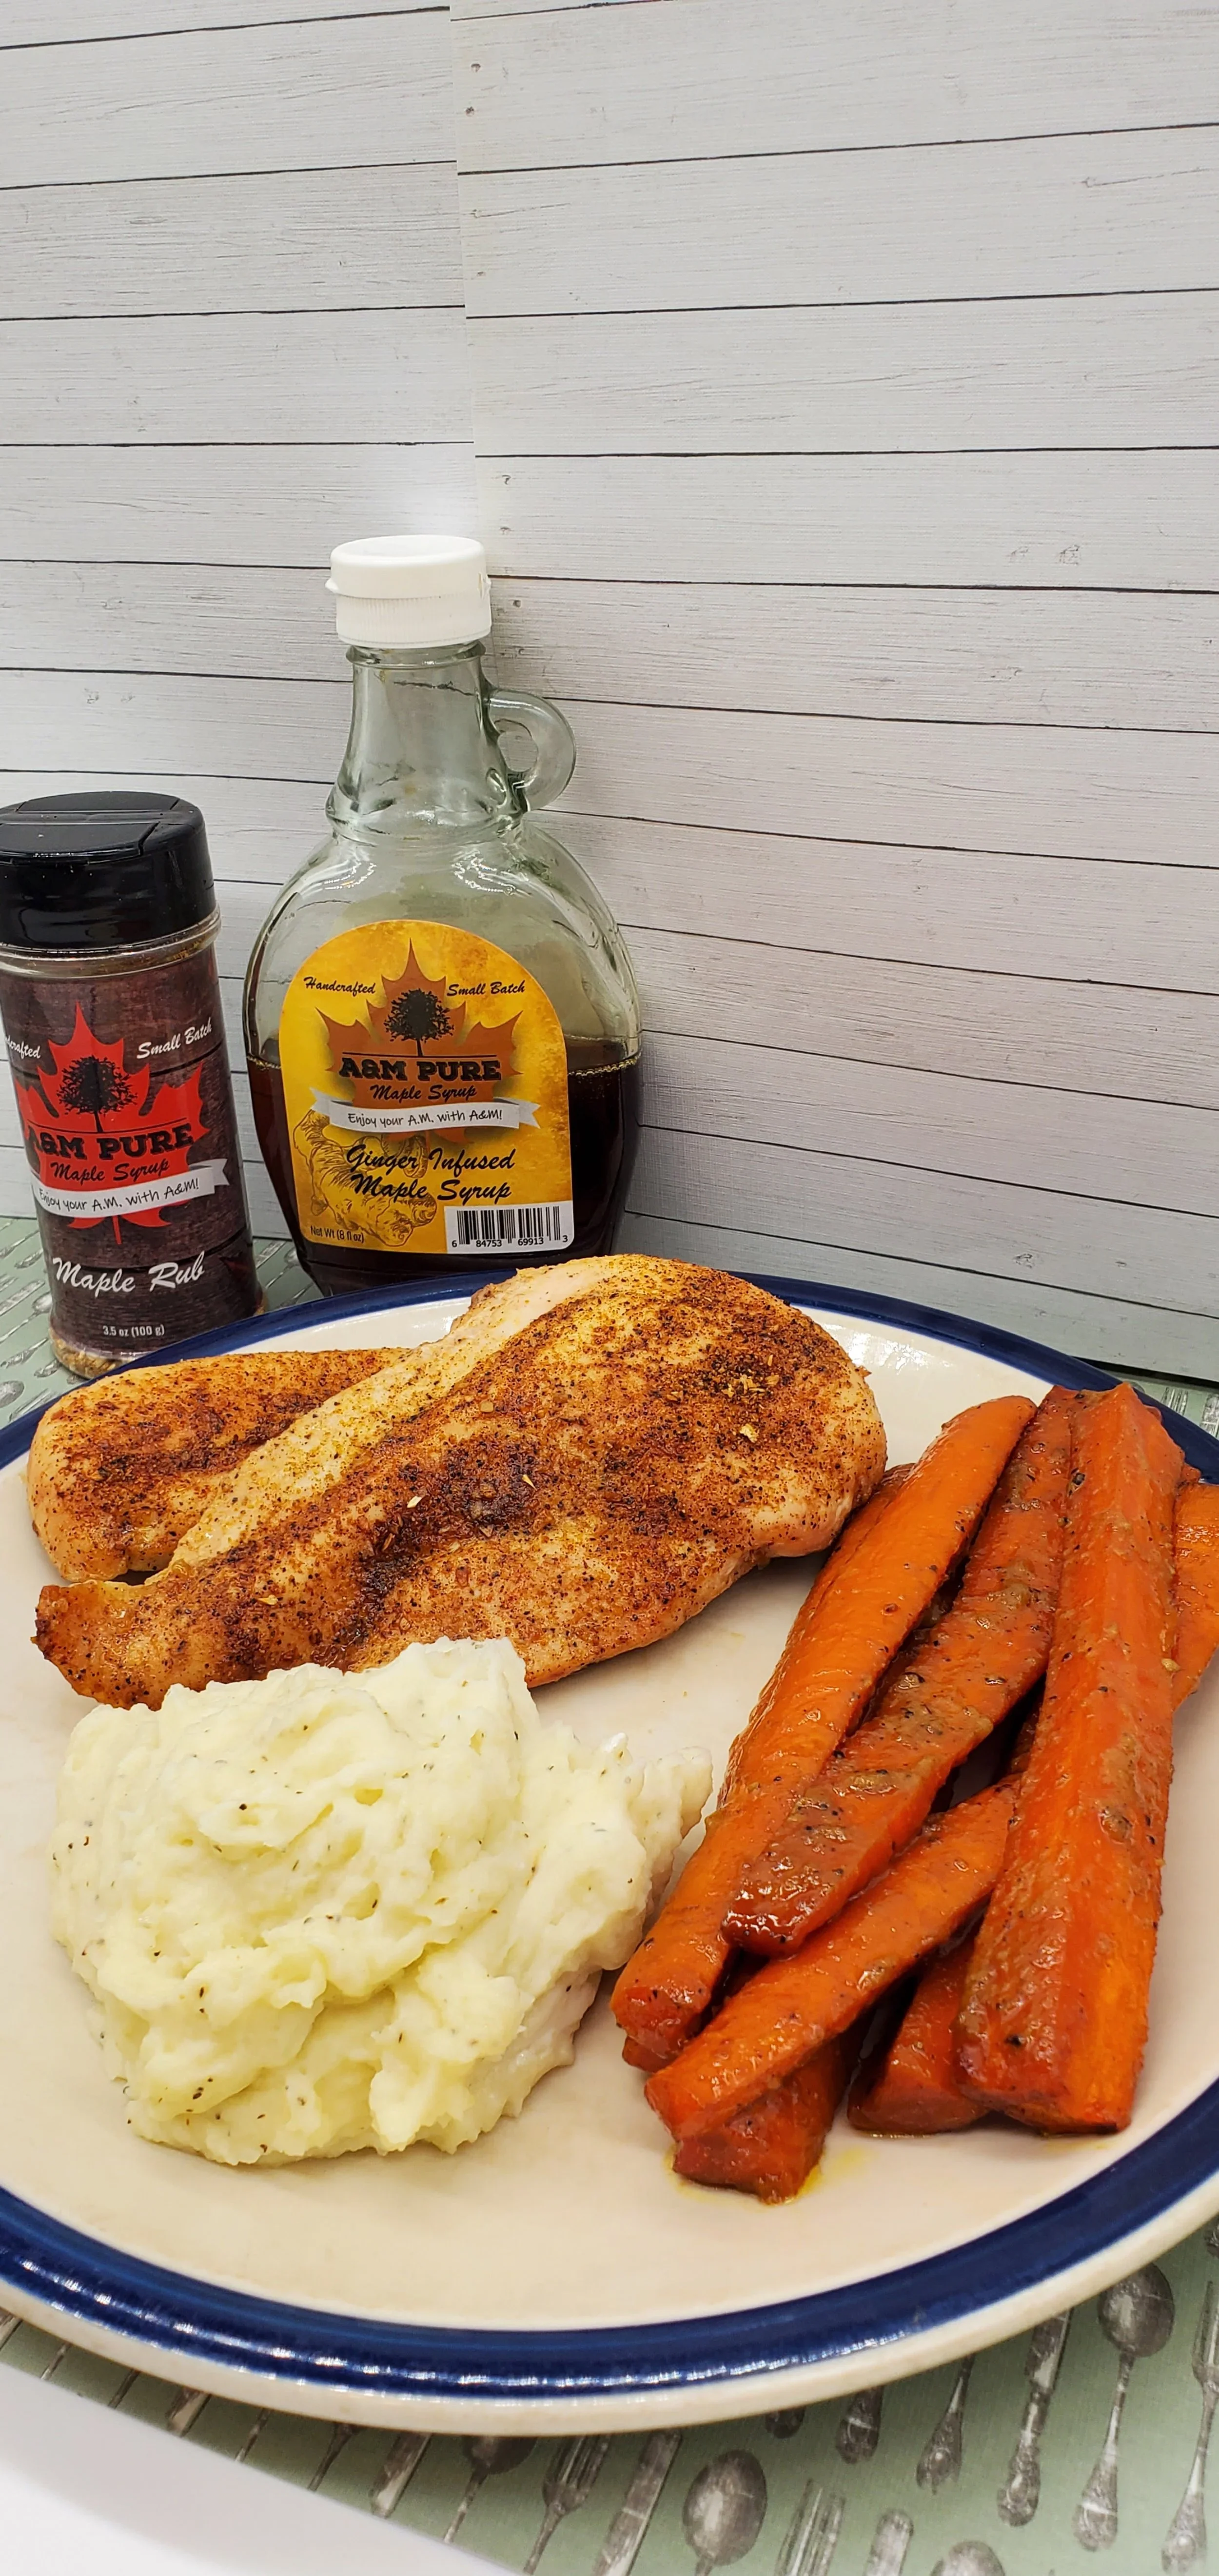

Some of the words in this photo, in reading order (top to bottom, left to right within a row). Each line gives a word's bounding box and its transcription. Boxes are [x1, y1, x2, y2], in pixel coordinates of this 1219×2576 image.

[303, 976, 376, 996] Handcrafted
[447, 983, 486, 996] Small
[490, 979, 525, 995] Batch
[5, 1034, 41, 1060] dcrafted
[137, 1037, 181, 1060] Small
[184, 1017, 212, 1045] Batch
[339, 1057, 407, 1081] A&M
[416, 1060, 502, 1082] PURE
[369, 1084, 422, 1102] Maple
[428, 1084, 477, 1101] Syrup
[348, 1112, 376, 1128] Enjoy
[380, 1116, 404, 1127] your
[408, 1115, 434, 1126] A.M.
[438, 1111, 466, 1122] with
[469, 1109, 503, 1121] A&M!
[28, 1125, 87, 1160] A&M
[96, 1123, 194, 1160] PURE
[50, 1162, 105, 1185] Maple
[113, 1158, 170, 1182] Syrup
[346, 1143, 418, 1172] Ginger
[428, 1147, 516, 1177] Infused
[39, 1188, 61, 1210] Enjoy
[62, 1200, 87, 1212] your
[92, 1196, 123, 1212] A.M.
[126, 1191, 160, 1206] with
[164, 1178, 199, 1200] A&M!
[351, 1174, 428, 1204] Maple
[437, 1180, 511, 1205] Syrup
[311, 1225, 323, 1237] Net
[324, 1228, 334, 1239] Wt
[337, 1229, 345, 1240] (8
[353, 1233, 364, 1244] oz)
[517, 1237, 544, 1246] 69913
[52, 1257, 136, 1298] Maple
[148, 1251, 205, 1292] Rub
[102, 1326, 118, 1336] 3.5
[119, 1327, 129, 1336] oz
[131, 1326, 153, 1337] (100
[155, 1324, 165, 1336] g)
